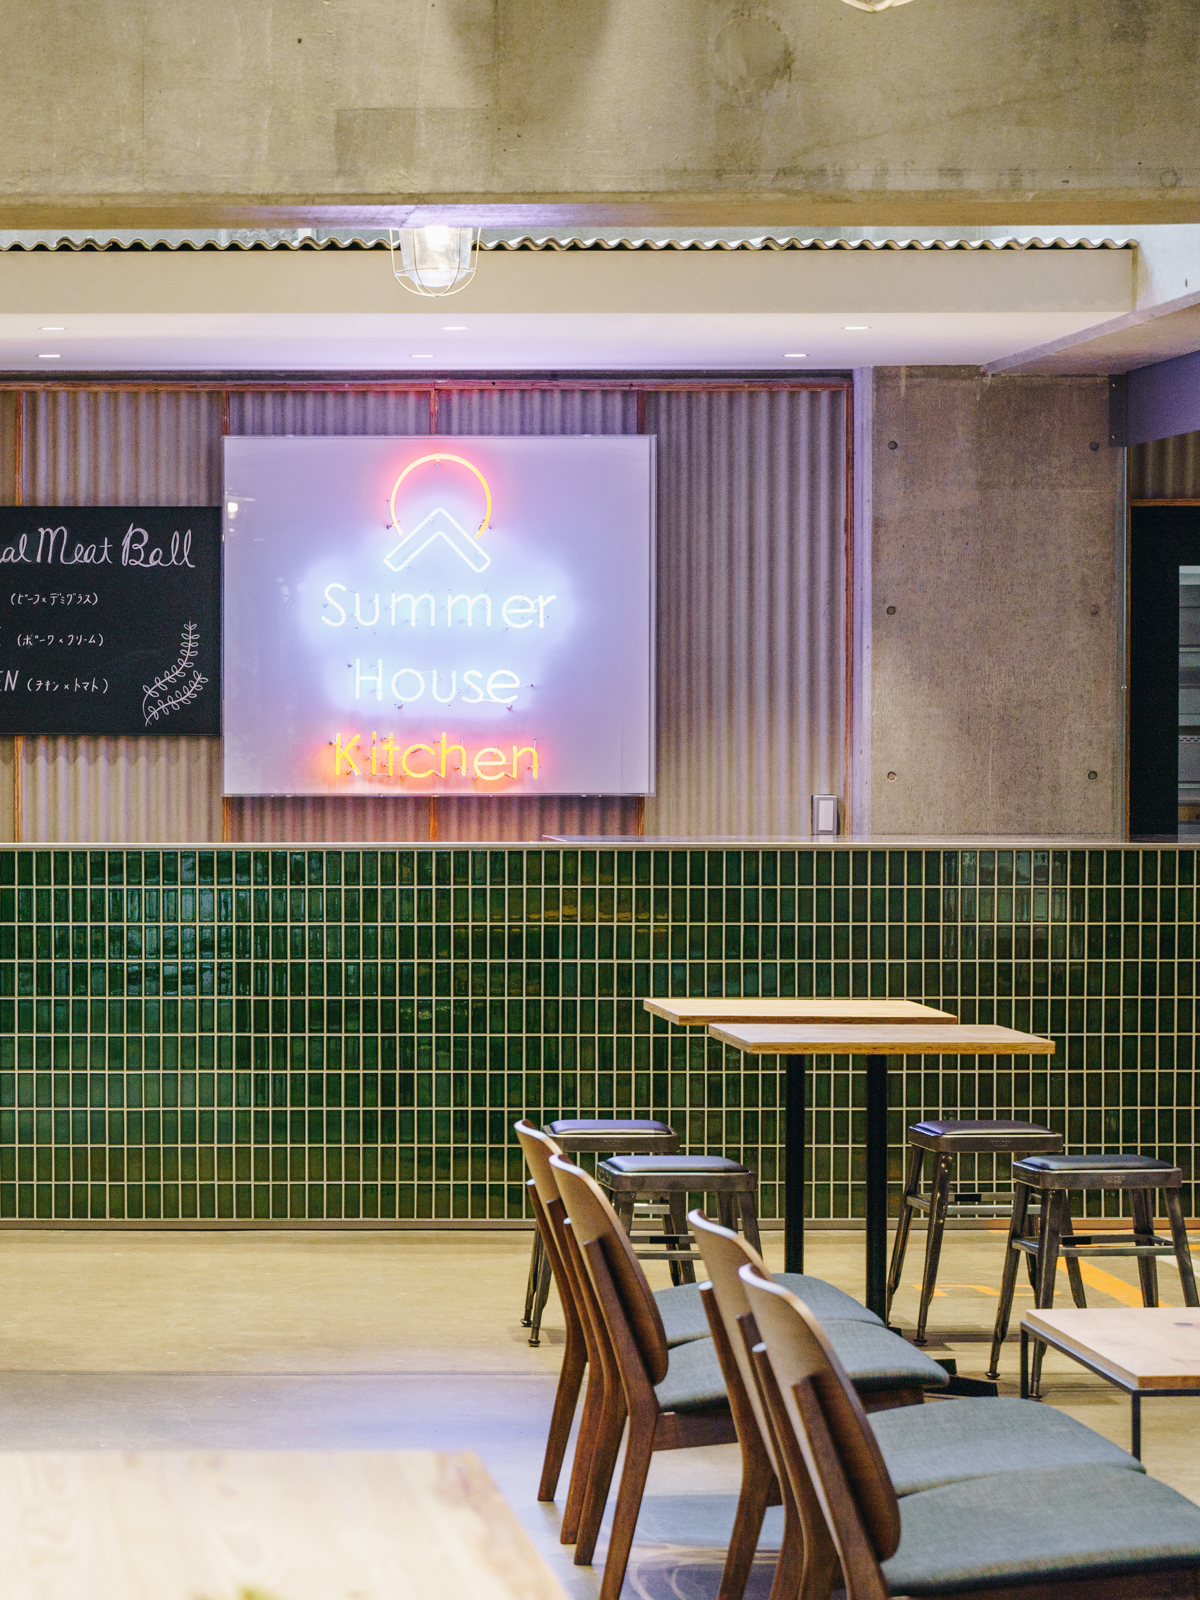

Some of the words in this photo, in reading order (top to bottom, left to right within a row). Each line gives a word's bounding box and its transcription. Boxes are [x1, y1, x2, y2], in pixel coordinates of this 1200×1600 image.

[35, 526, 113, 565] Meat
[121, 522, 196, 568] Ball
[320, 583, 557, 629] Summer
[354, 658, 521, 704] House
[334, 731, 539, 781] Kitchen
